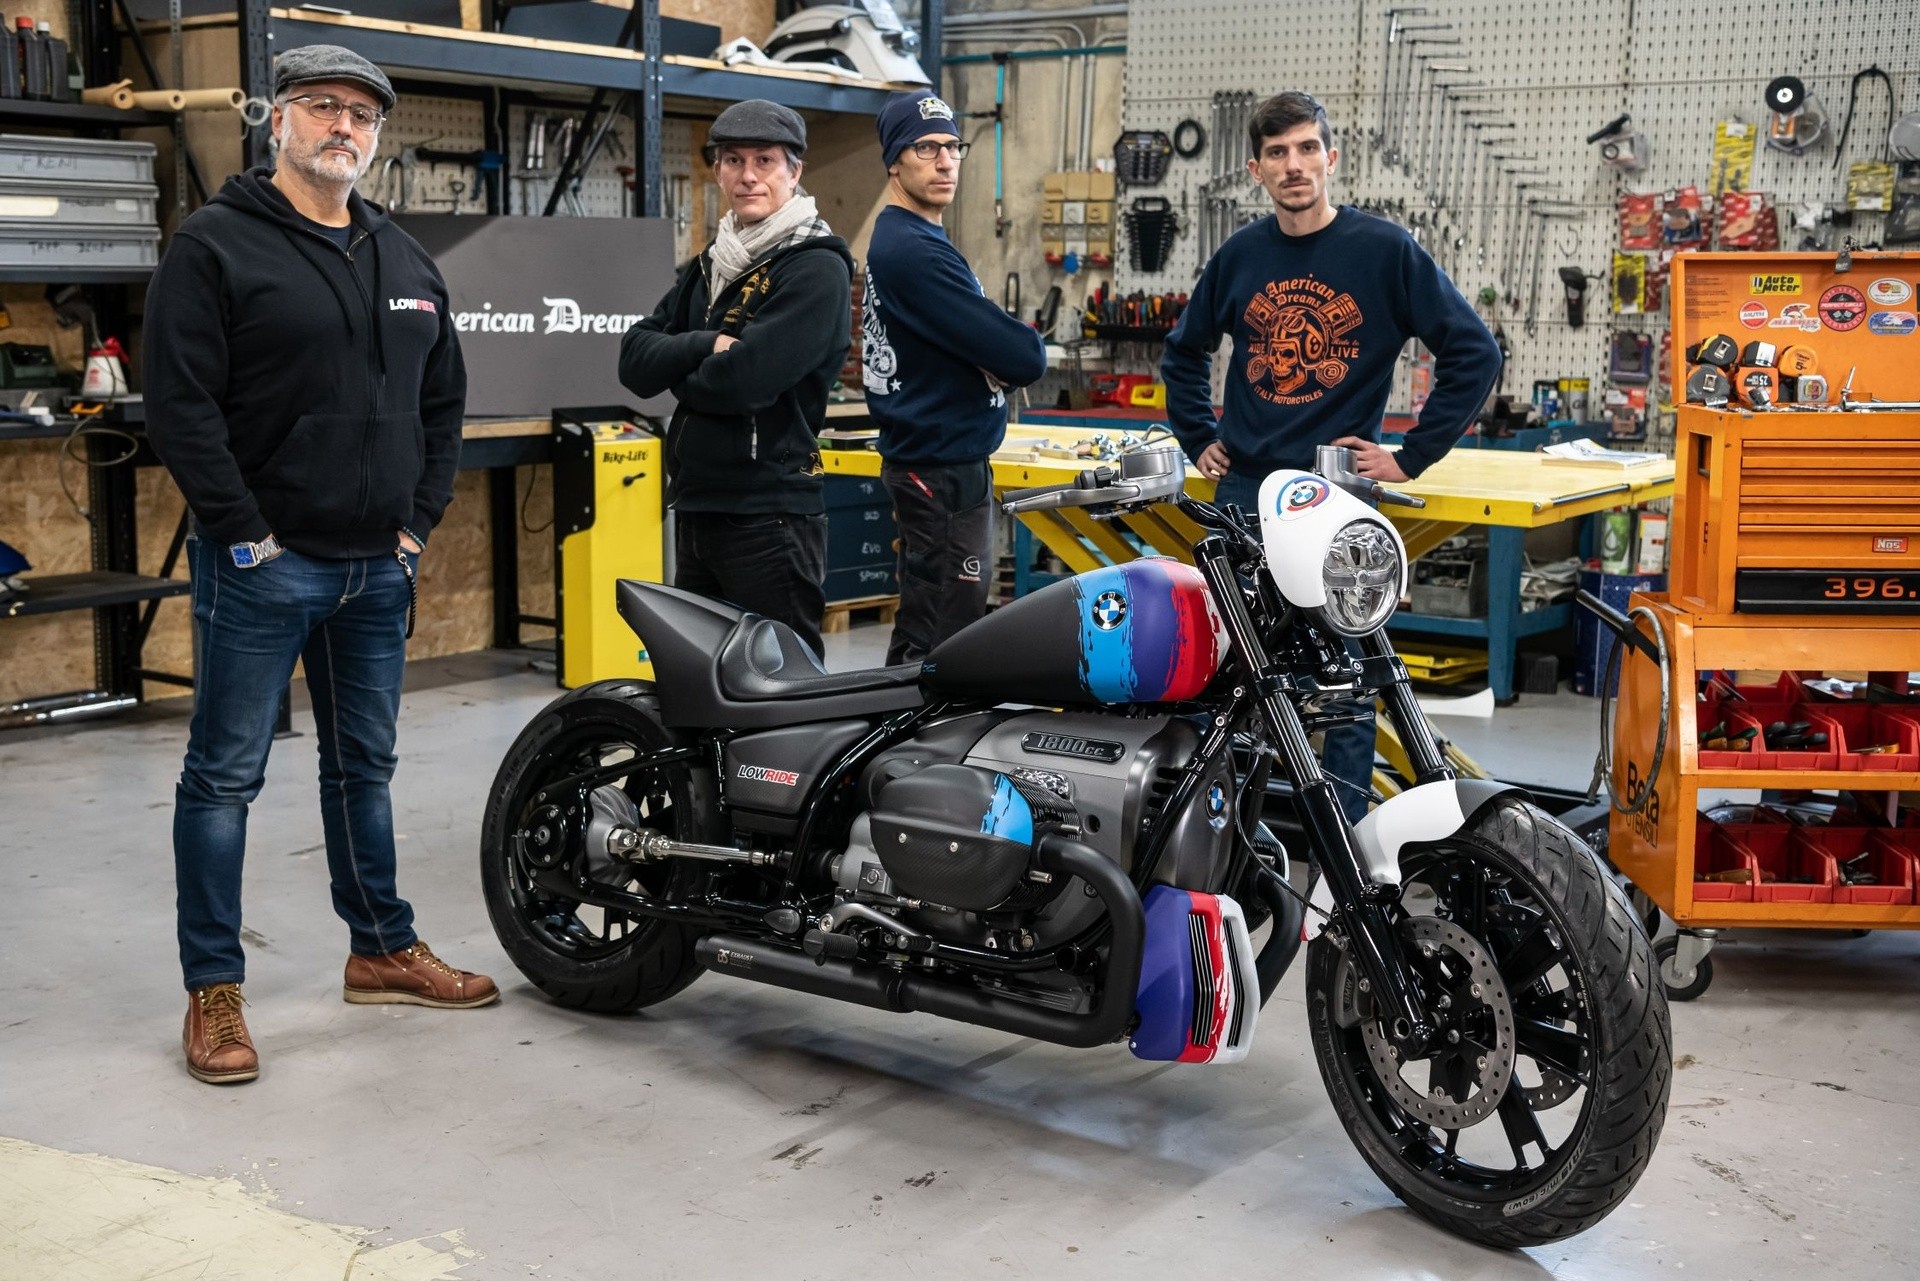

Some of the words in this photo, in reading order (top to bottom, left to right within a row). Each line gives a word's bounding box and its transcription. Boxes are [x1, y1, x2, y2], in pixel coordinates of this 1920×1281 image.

[1763, 284, 1800, 293] Meter
[1765, 276, 1794, 284] Auto
[1266, 278, 1335, 300] American
[1274, 294, 1322, 308] Dreams
[450, 302, 535, 333] erican
[542, 296, 646, 335] Dream
[1330, 346, 1359, 358] LIVE
[1254, 385, 1274, 400] ITALY
[1273, 389, 1323, 405] MOTORCYCLES
[603, 451, 648, 463] Bike-Lift
[1037, 734, 1105, 756] 1800cc
[738, 765, 798, 785] LOWRIDE
